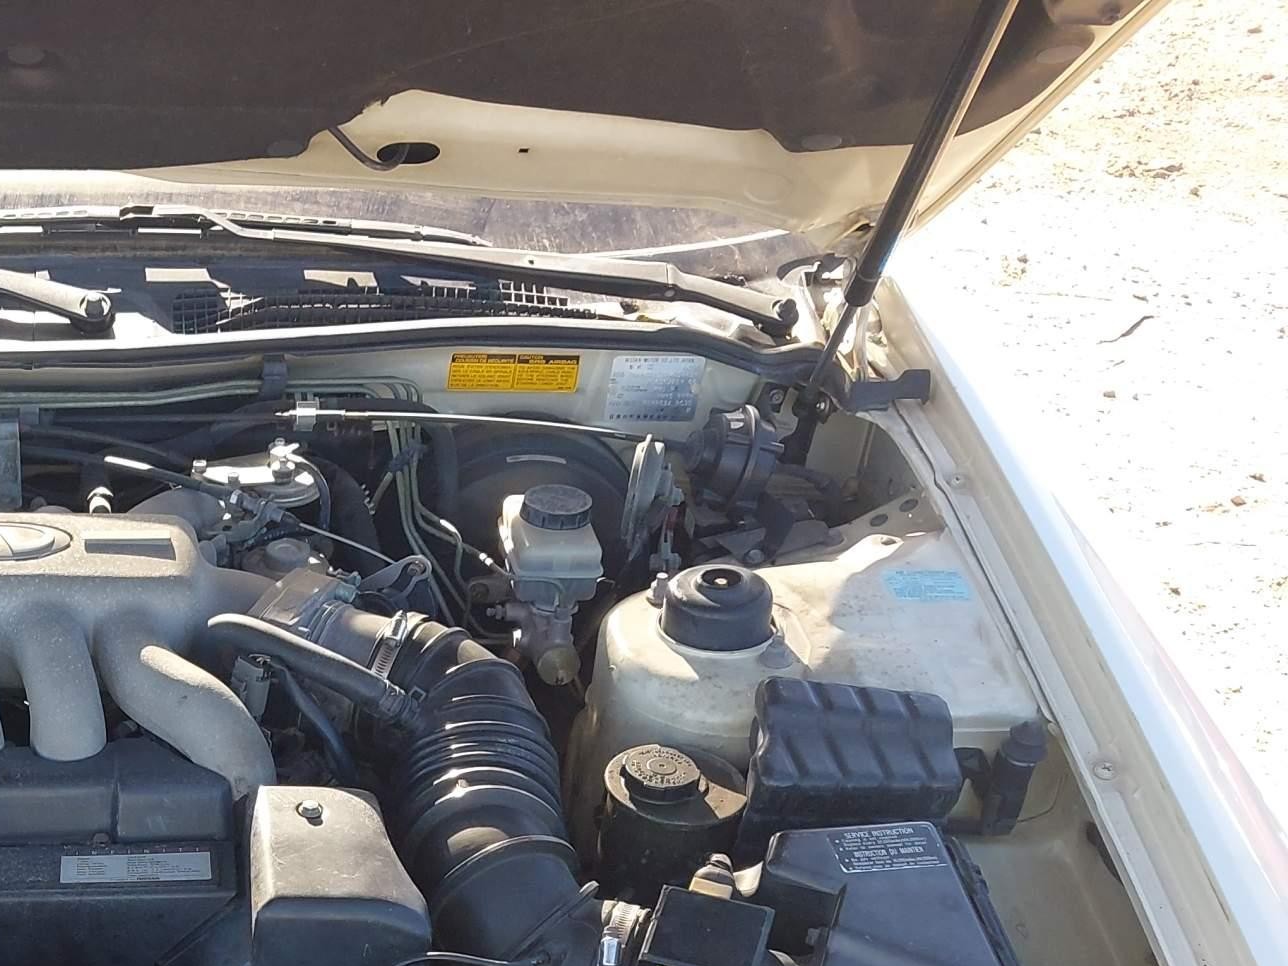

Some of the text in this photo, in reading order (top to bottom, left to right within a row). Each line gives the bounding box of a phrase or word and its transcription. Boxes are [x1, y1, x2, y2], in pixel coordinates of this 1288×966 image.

[844, 828, 914, 839] SERVICE INSTRUCTION
[853, 849, 888, 858] INSTRUCTION
[899, 846, 924, 854] MAINTIEN
